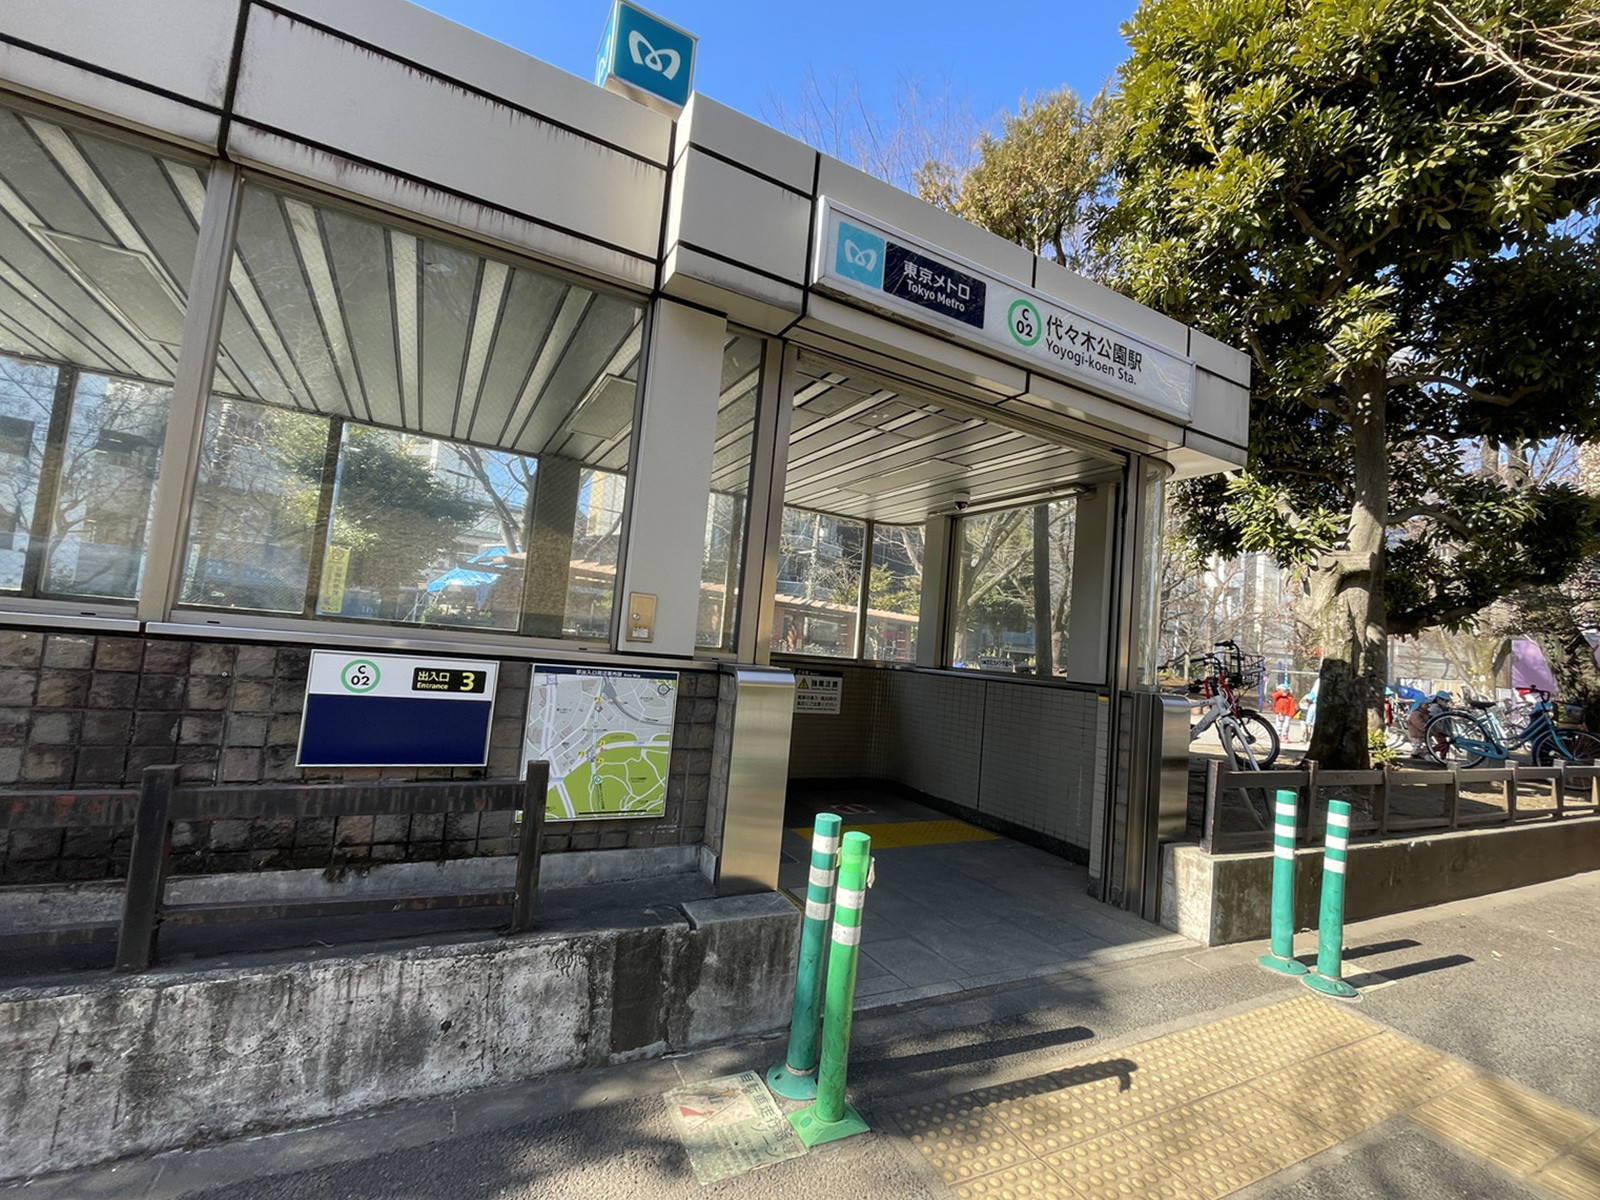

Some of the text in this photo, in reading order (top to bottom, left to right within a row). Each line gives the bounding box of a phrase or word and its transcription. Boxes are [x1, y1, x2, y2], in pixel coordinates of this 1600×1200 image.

[903, 259, 970, 300] 東京メトロ
[906, 279, 965, 312] Tokyo Metro
[1022, 308, 1030, 321] C
[1016, 320, 1033, 338] 02
[1046, 315, 1143, 373] 代々木公園駅
[1045, 338, 1137, 386] Yoyogi-koen Sta.
[357, 665, 367, 675] C
[417, 670, 450, 682] 出入口
[351, 675, 370, 686] 02
[416, 681, 449, 690] Entrance
[460, 672, 475, 691] 3
